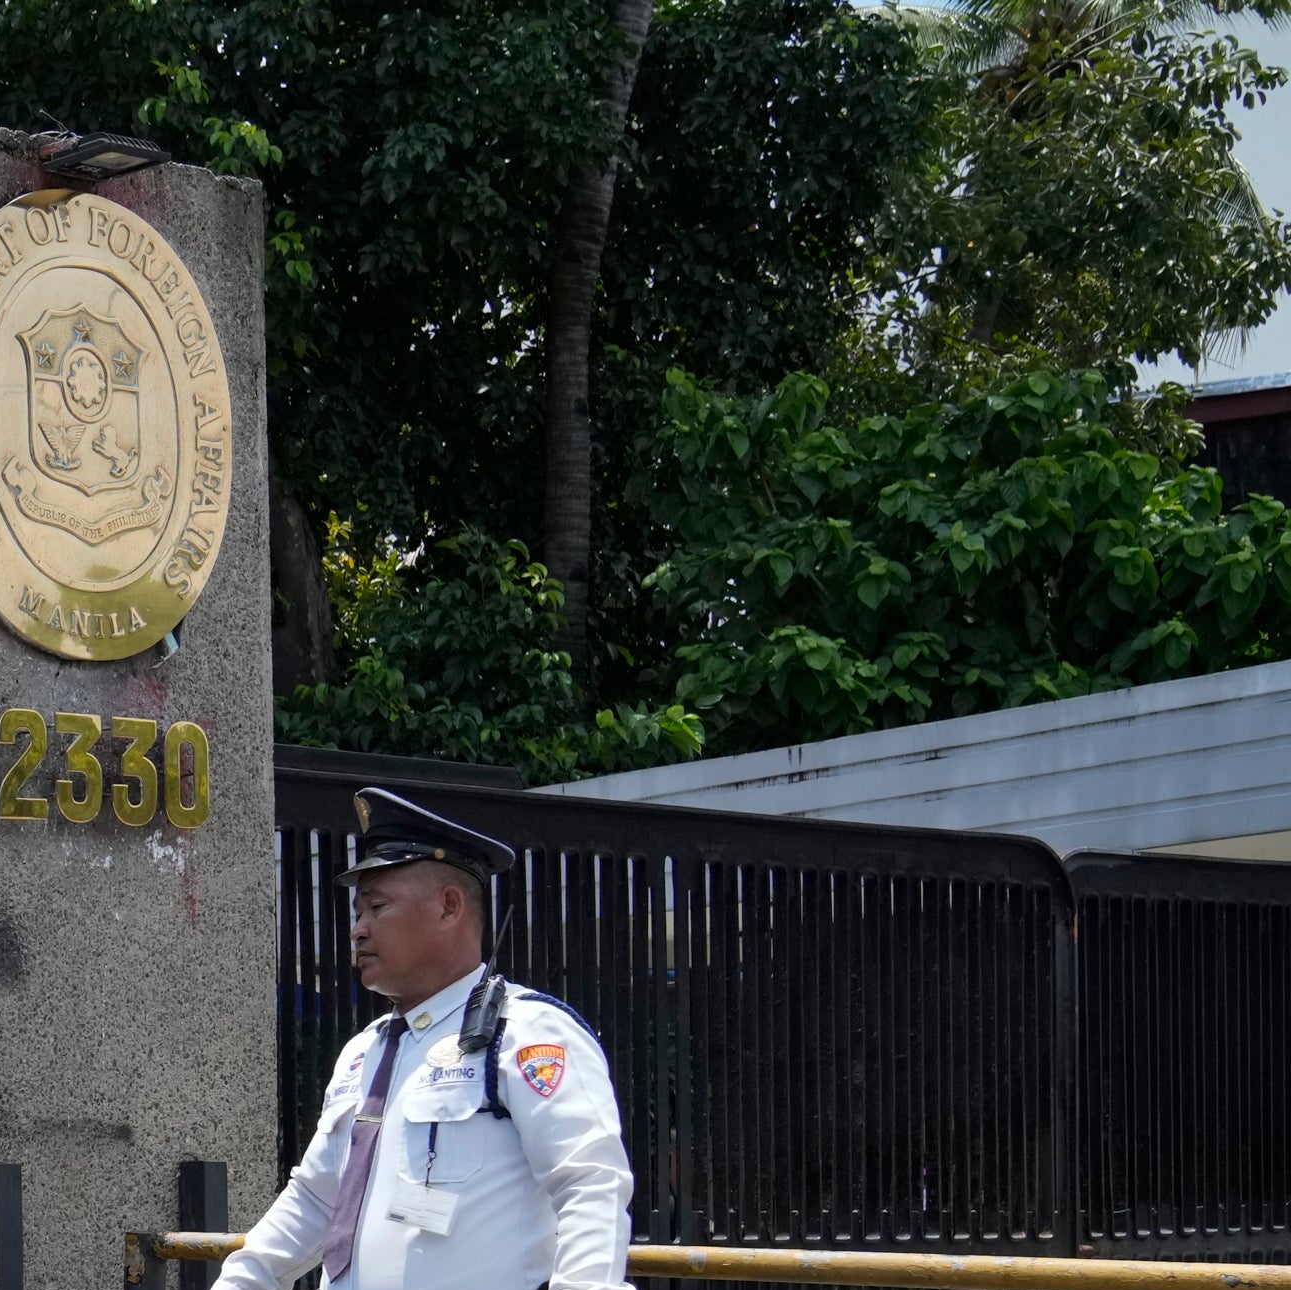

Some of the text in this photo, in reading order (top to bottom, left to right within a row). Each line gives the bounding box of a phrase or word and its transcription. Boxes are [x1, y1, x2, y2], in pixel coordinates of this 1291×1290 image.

[25, 203, 72, 247] OF
[87, 207, 217, 380] FOREIGN
[163, 393, 225, 602] AFFAIRS
[21, 494, 66, 523] REPUBLIC
[69, 518, 82, 531] OF
[84, 527, 104, 539] THE
[19, 584, 149, 639] MANILA
[0, 708, 209, 829] 2330
[432, 1067, 475, 1082] LANTING
